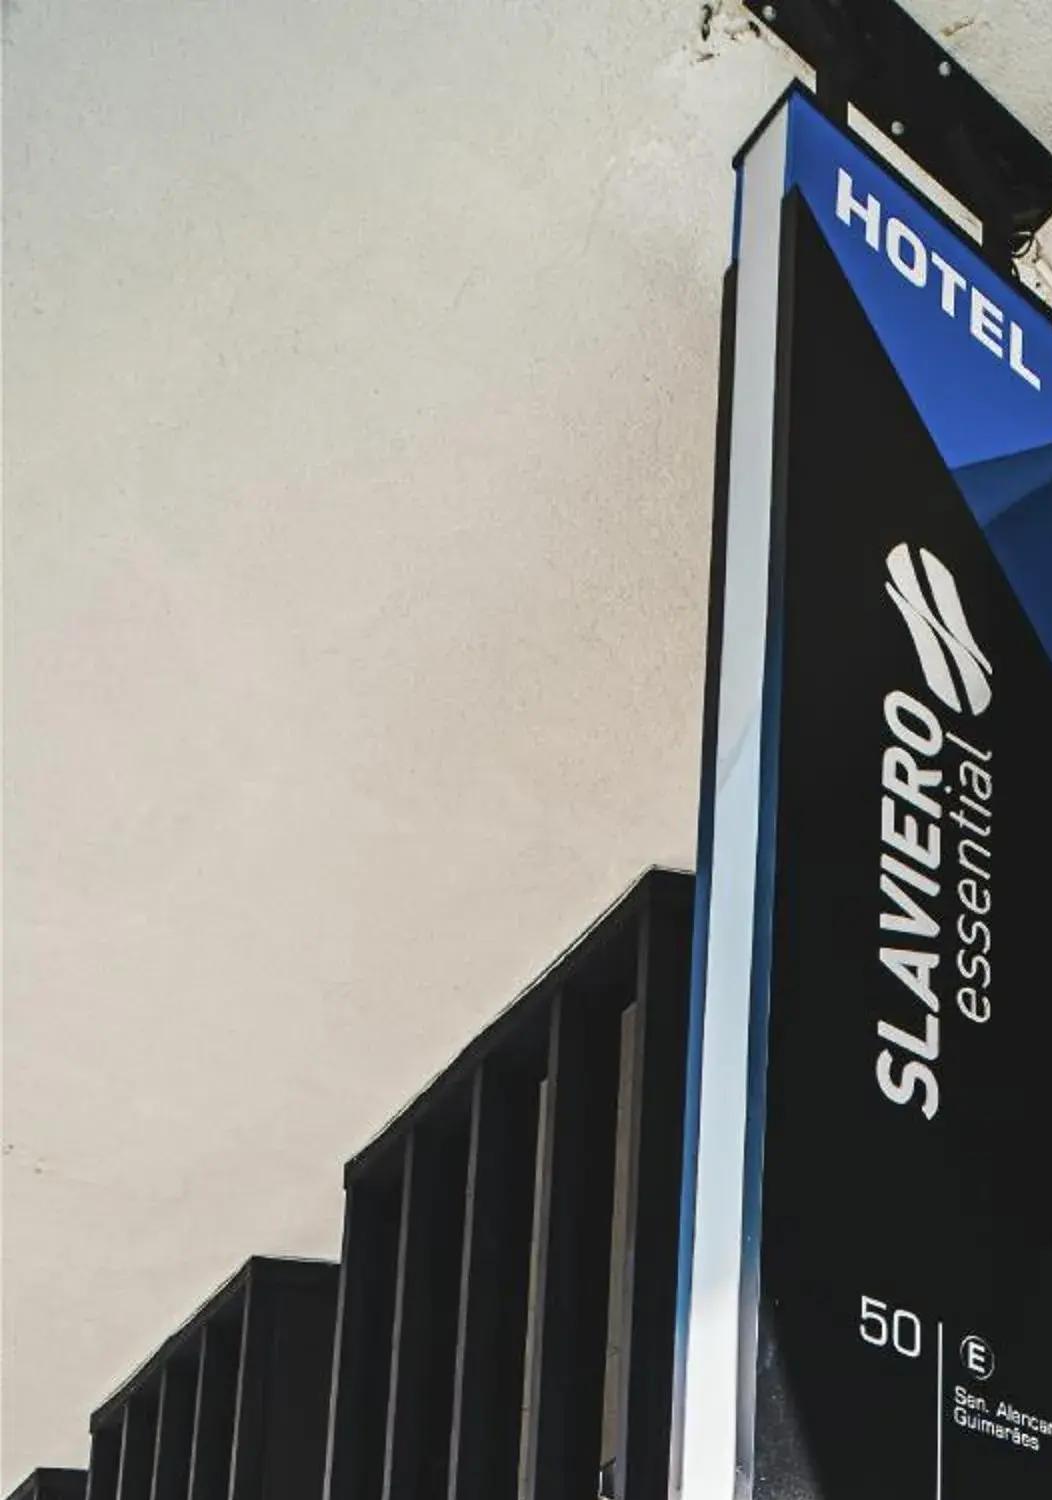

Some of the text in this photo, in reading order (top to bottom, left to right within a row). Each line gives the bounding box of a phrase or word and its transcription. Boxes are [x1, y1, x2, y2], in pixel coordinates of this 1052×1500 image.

[836, 167, 1040, 391] HOTEL
[876, 690, 943, 1120] SLAVIERO
[945, 732, 992, 1023] essential
[859, 1295, 921, 1358] 50
[965, 1338, 988, 1375] E
